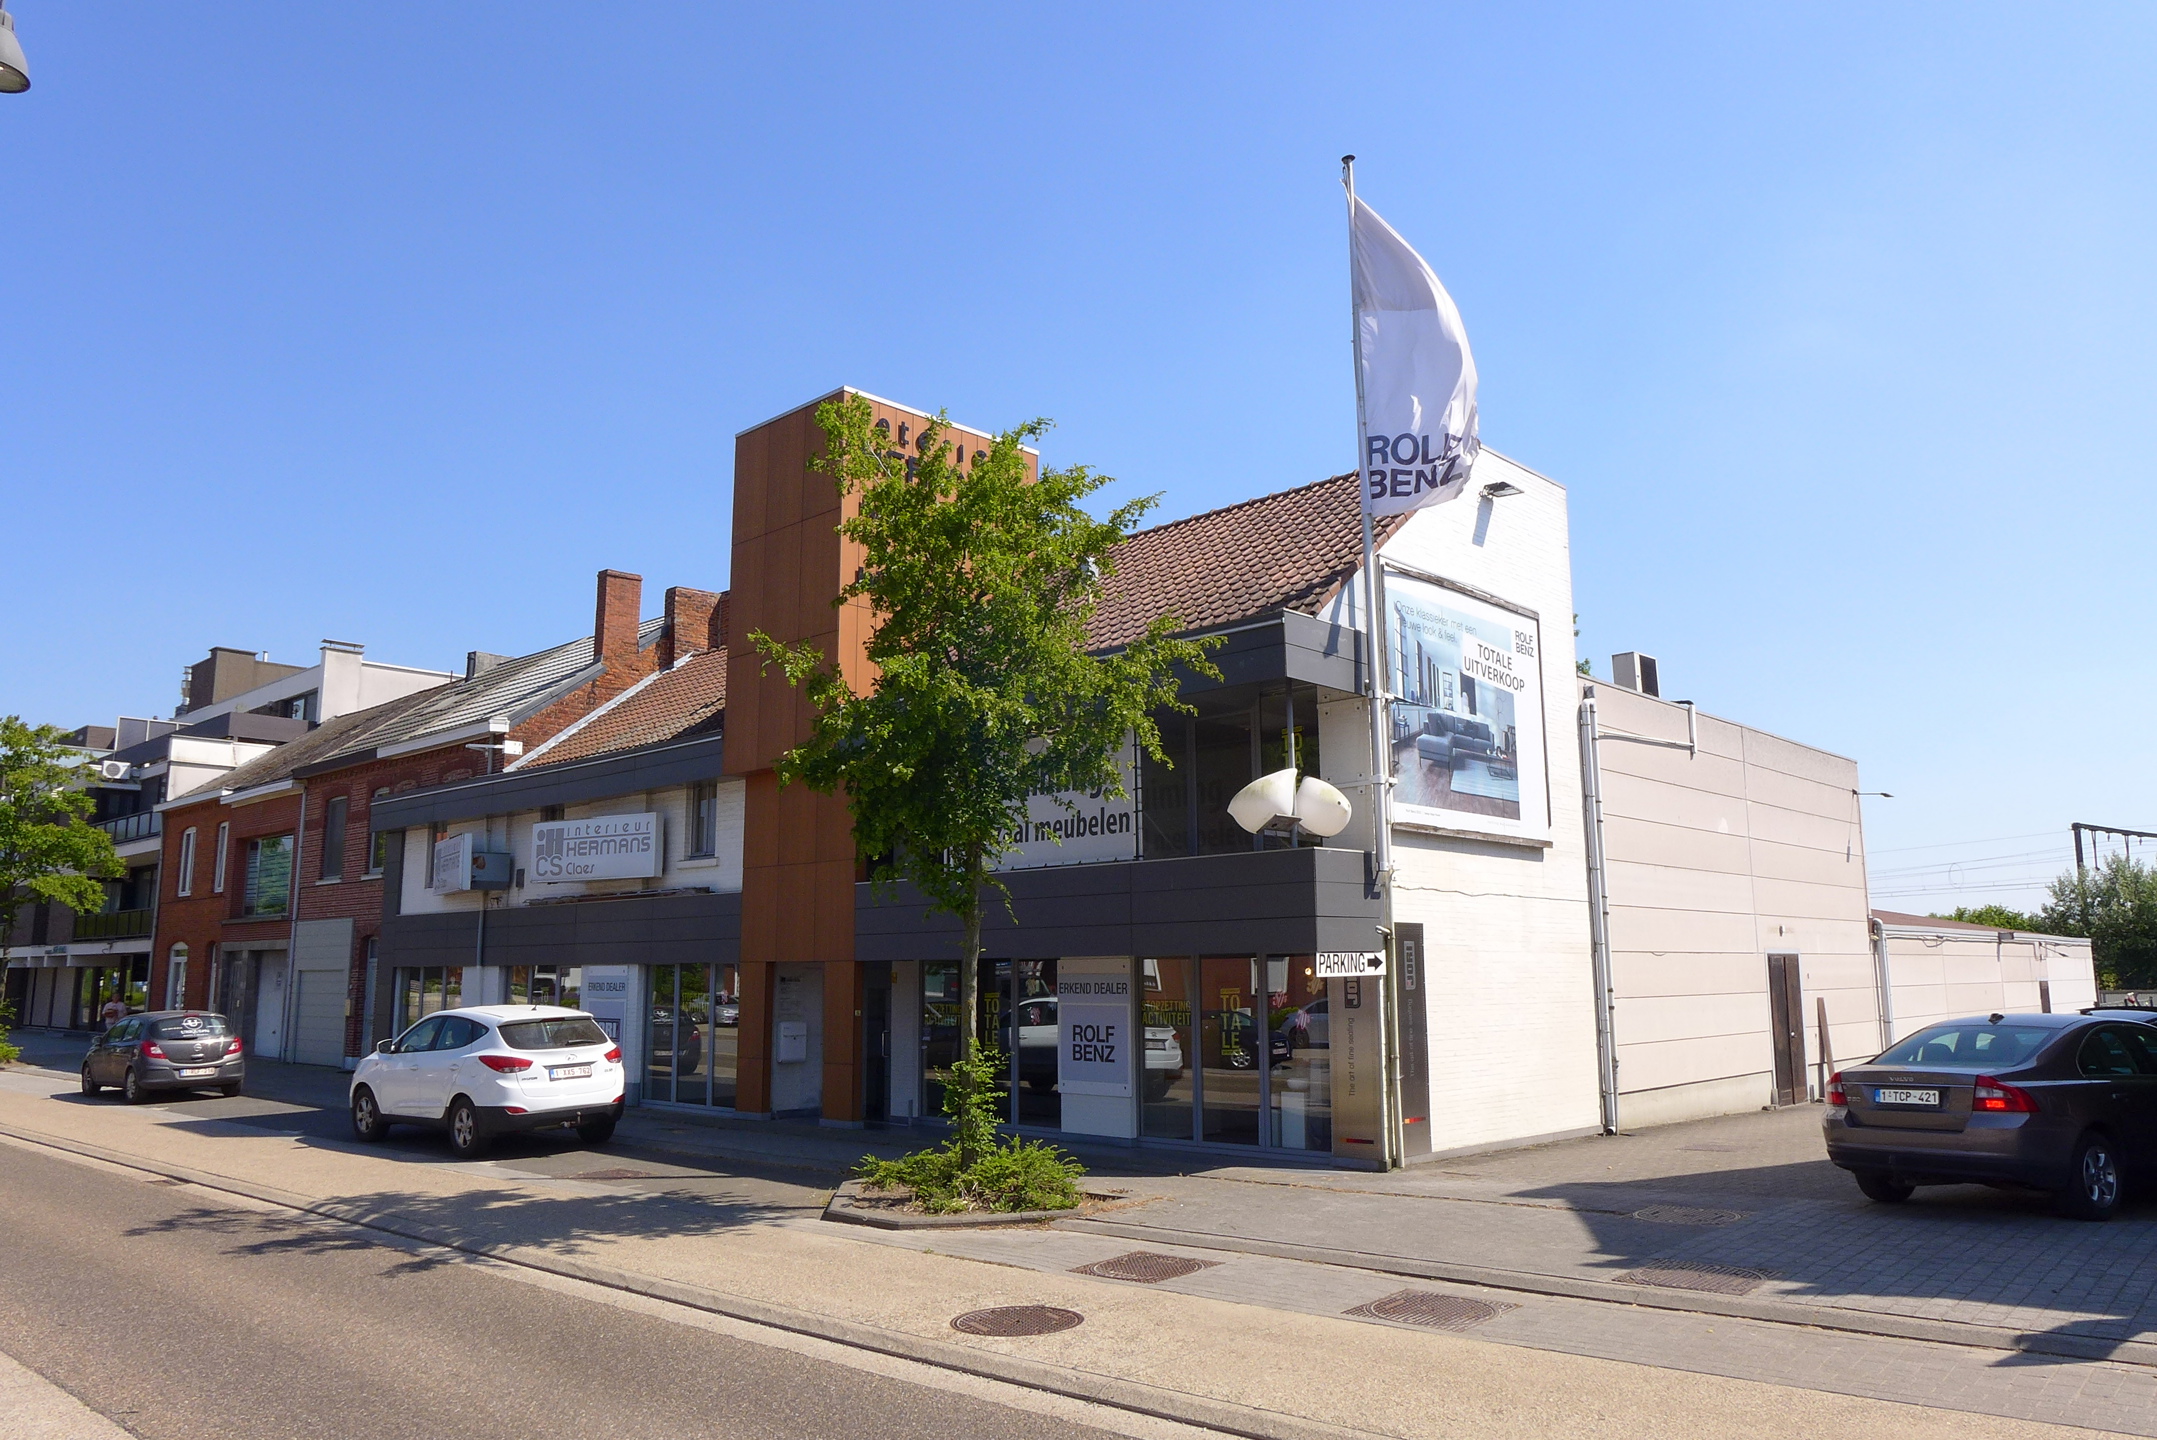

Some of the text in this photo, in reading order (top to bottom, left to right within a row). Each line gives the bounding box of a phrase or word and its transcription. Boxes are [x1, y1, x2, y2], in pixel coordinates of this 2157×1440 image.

[1367, 432, 1463, 467] ROLF
[1369, 454, 1464, 500] BENZ
[1416, 606, 1449, 627] klassieker
[1450, 620, 1464, 632] met
[1465, 624, 1478, 636] een
[1422, 622, 1437, 637] look
[1514, 630, 1534, 645] ROLF
[1477, 643, 1513, 672] TOTALE
[1515, 642, 1535, 658] BENZ
[1464, 656, 1525, 693] UITVERKOOP
[566, 820, 651, 837] interieur
[1034, 807, 1130, 842] meubelen
[566, 836, 651, 857] HERMANS
[536, 855, 595, 877] CS Claes
[1318, 952, 1366, 974] PARKING
[605, 982, 626, 992] DEALER
[1059, 982, 1128, 995] ERKEND DEALER
[1220, 995, 1241, 1011] TO
[1141, 1012, 1191, 1026] ACTIVITEIT
[1221, 1013, 1241, 1030] TA
[1072, 1025, 1115, 1043] ROLF
[1347, 1017, 1355, 1045] seating
[1222, 1032, 1240, 1049] LE
[1072, 1044, 1115, 1063] BENZ
[1348, 1062, 1355, 1070] of
[1348, 1083, 1356, 1097] The
